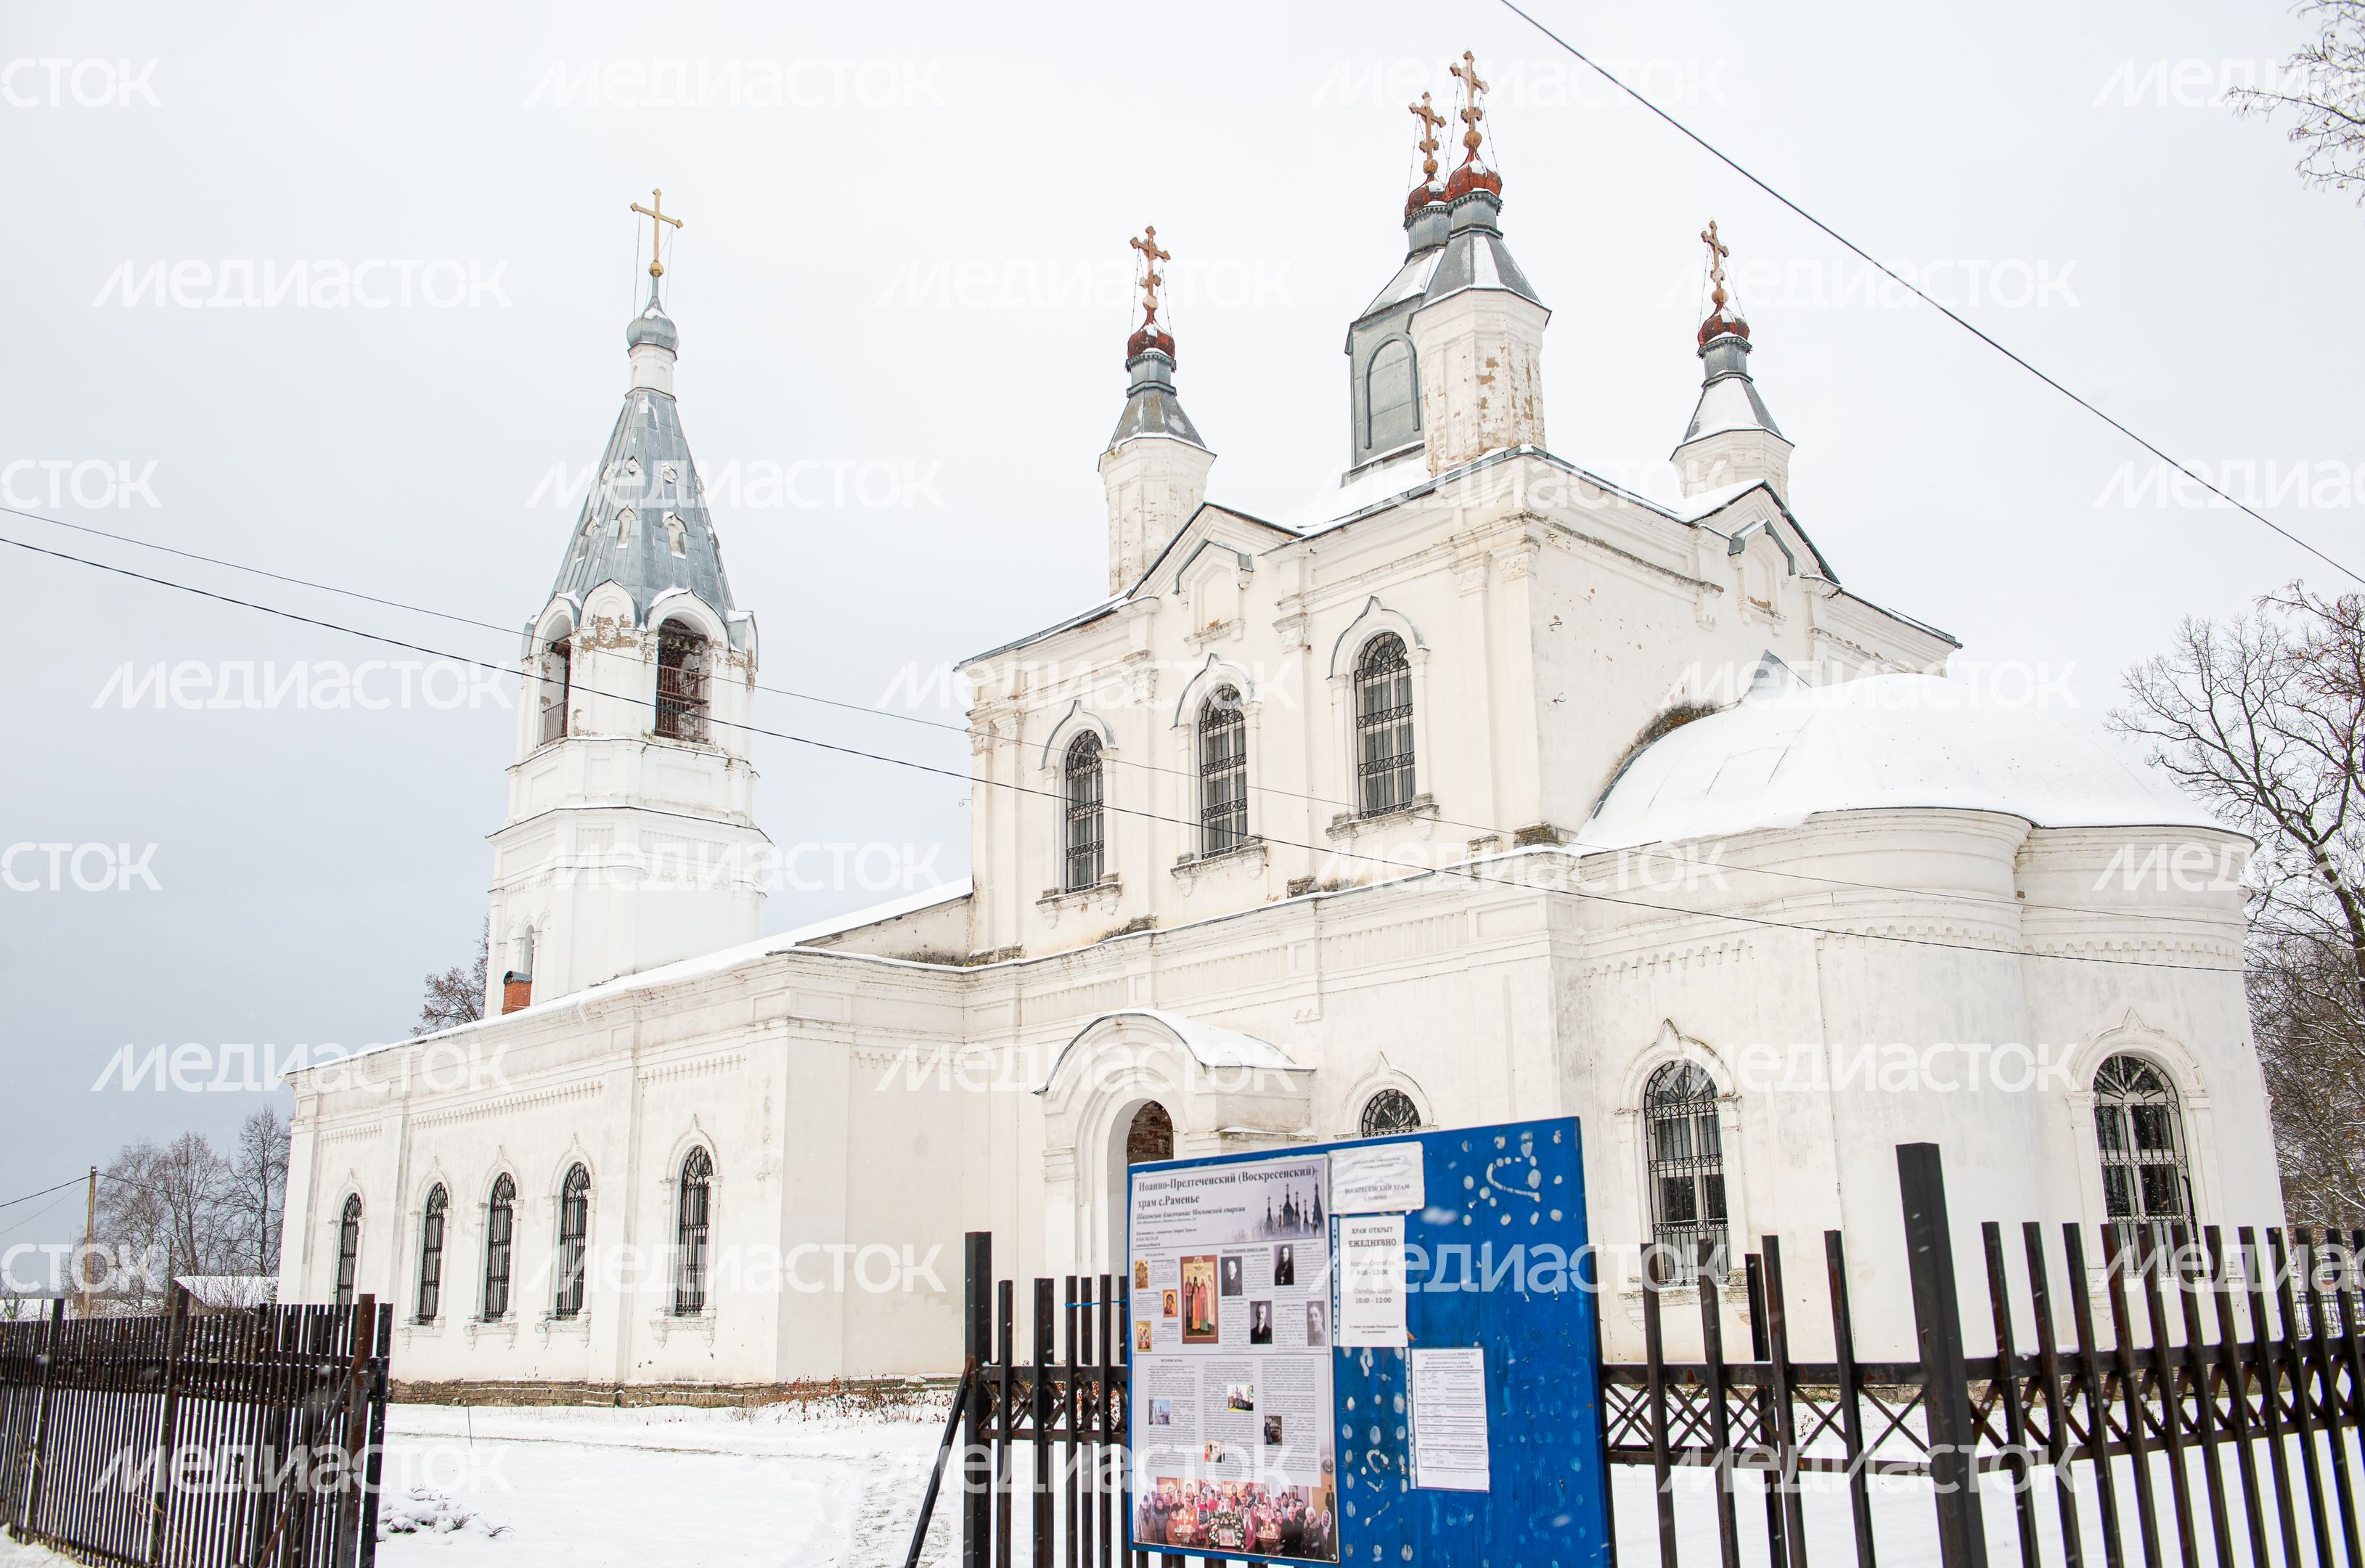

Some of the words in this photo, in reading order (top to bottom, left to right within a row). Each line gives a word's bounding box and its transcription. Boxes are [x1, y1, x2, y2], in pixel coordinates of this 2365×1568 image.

[1139, 1172, 1235, 1191] Иоанно-Предтеченский
[1238, 1166, 1315, 1184] (Воскресенский)
[1138, 1199, 1156, 1210] храм
[1159, 1195, 1200, 1206] с.Раменье
[1349, 1238, 1397, 1247] ЕЖЕДНЕВНО
